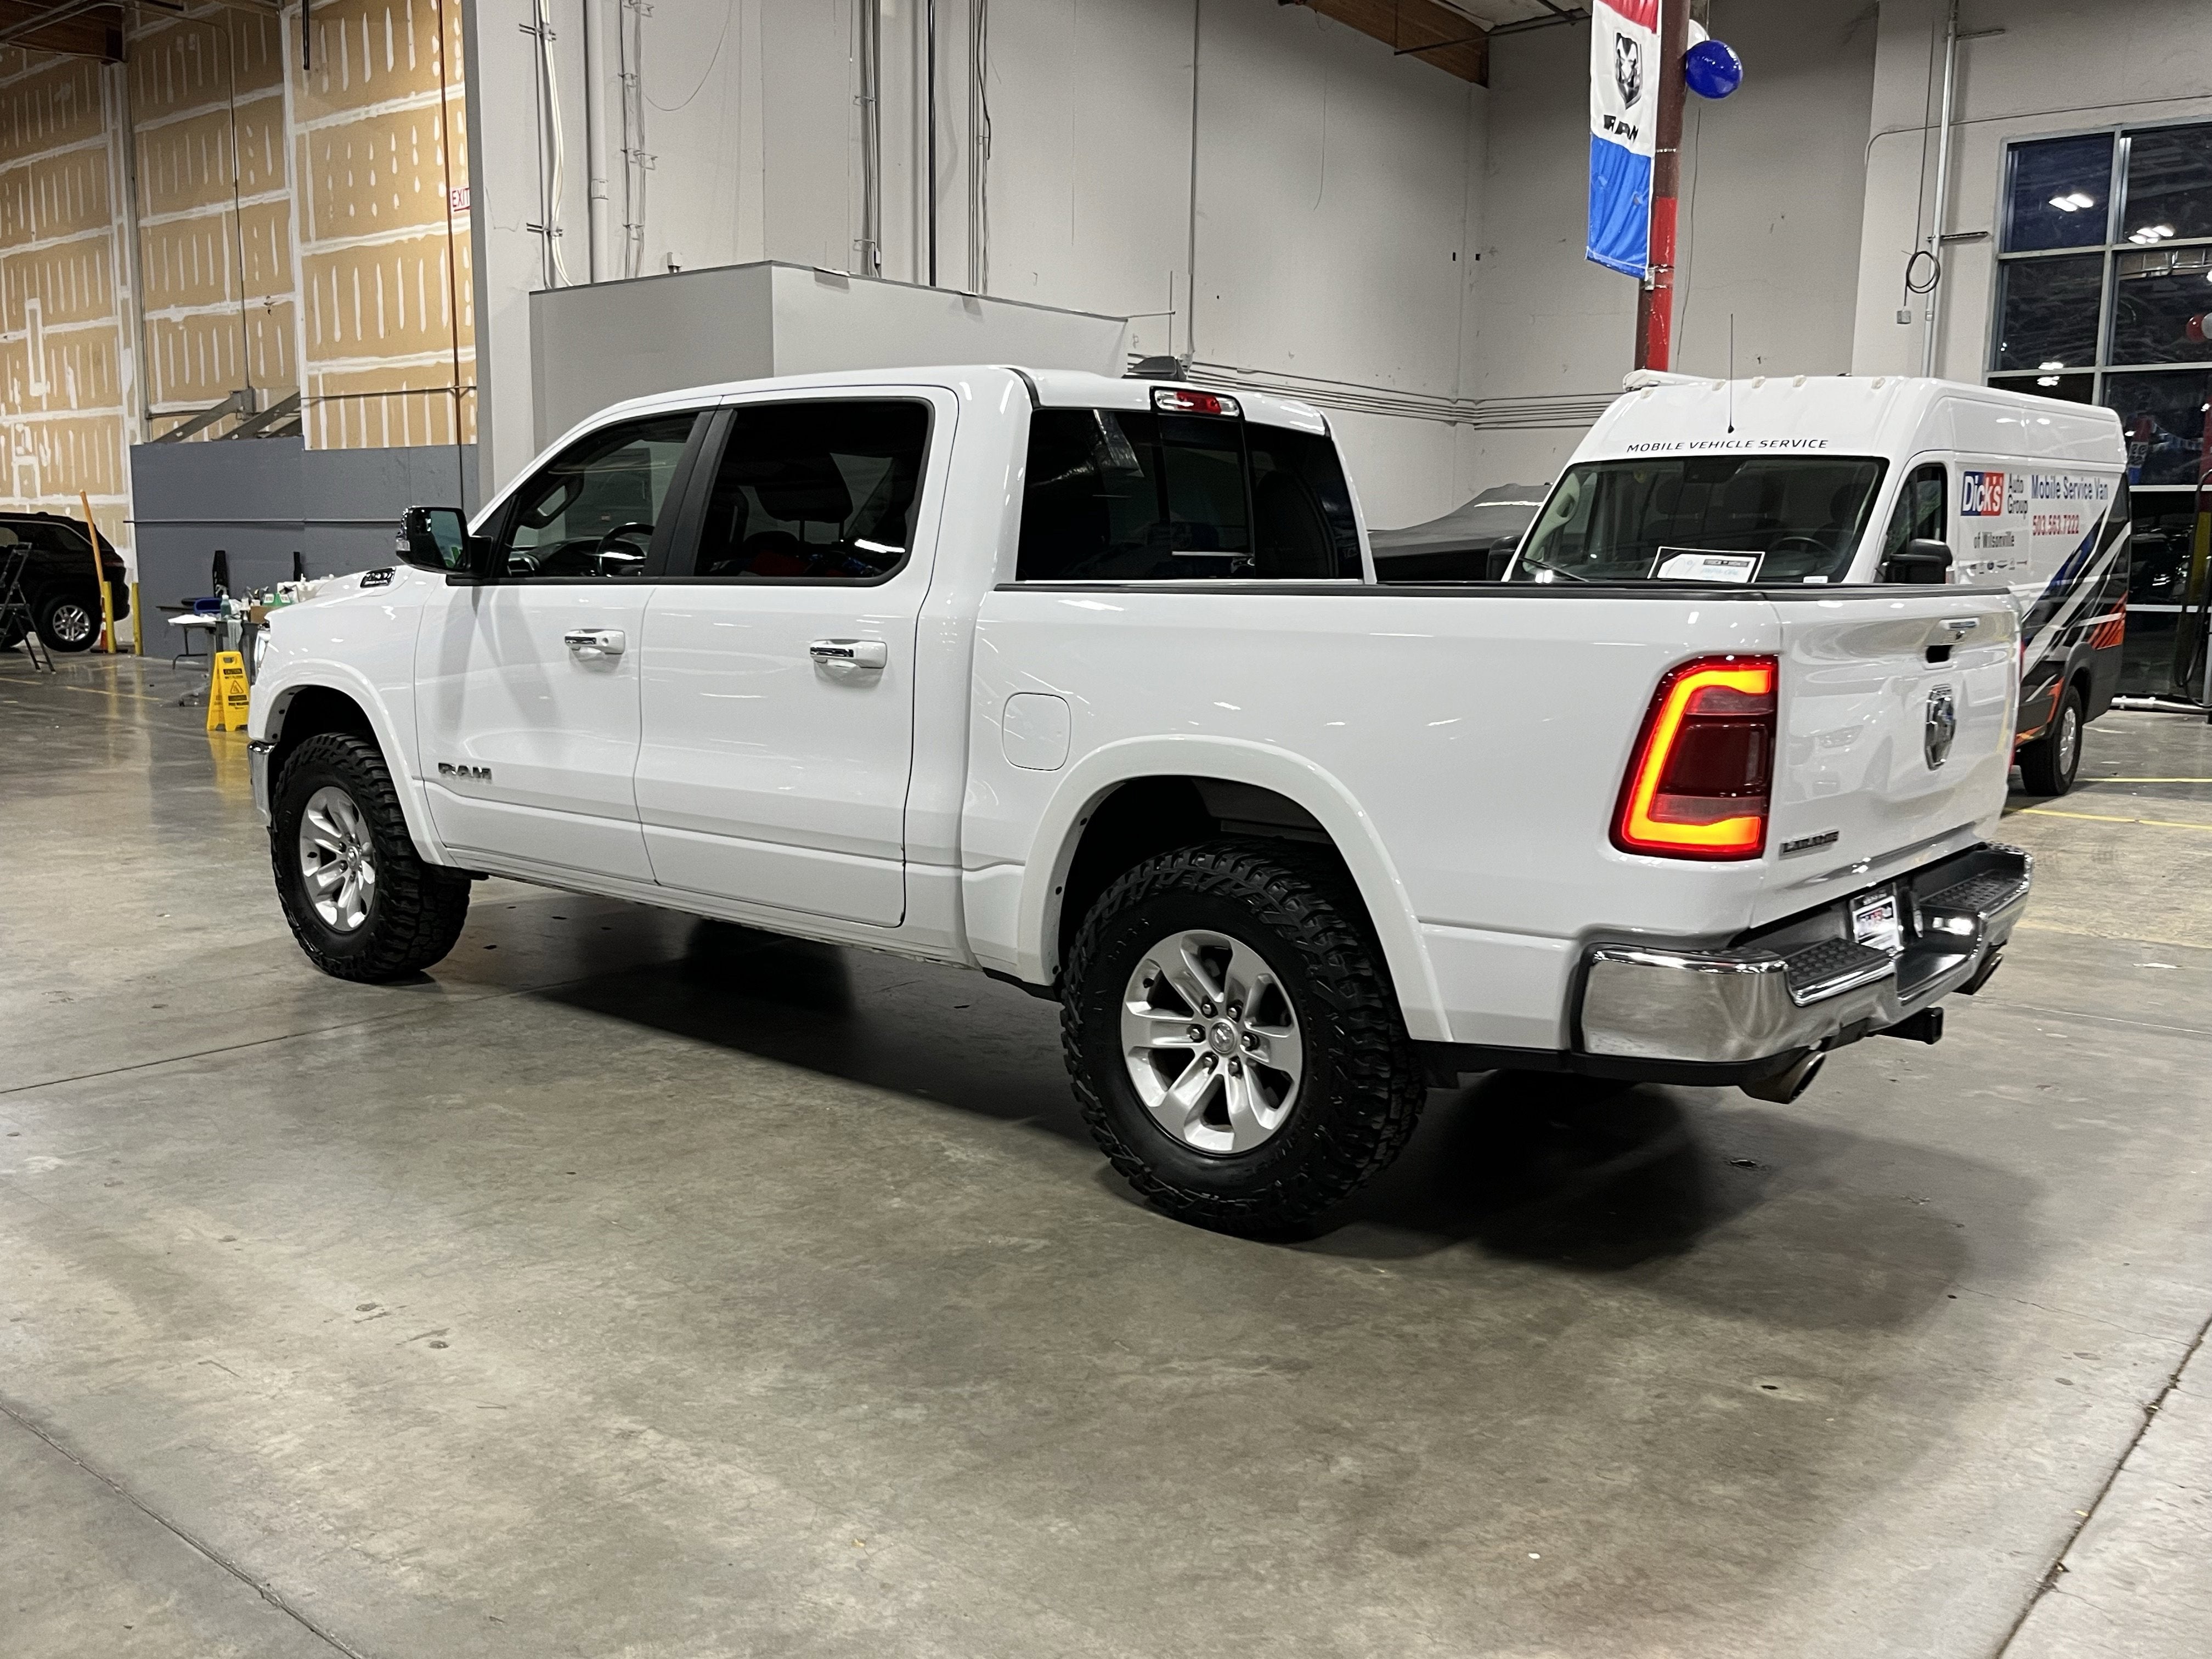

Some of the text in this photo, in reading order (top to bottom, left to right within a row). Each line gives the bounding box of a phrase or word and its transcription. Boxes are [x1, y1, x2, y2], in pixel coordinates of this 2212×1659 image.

[1603, 114, 1639, 143] RAM
[452, 188, 470, 207] EXIT
[1627, 439, 1829, 453] MOBILE VEHICLE SERVICE
[2008, 473, 2024, 493] Auto
[2031, 475, 2108, 500] Mobile Service Van
[1962, 475, 2002, 512] Dick's
[2007, 494, 2028, 520] Group
[1973, 531, 1981, 549] of
[438, 762, 492, 780] RAM
